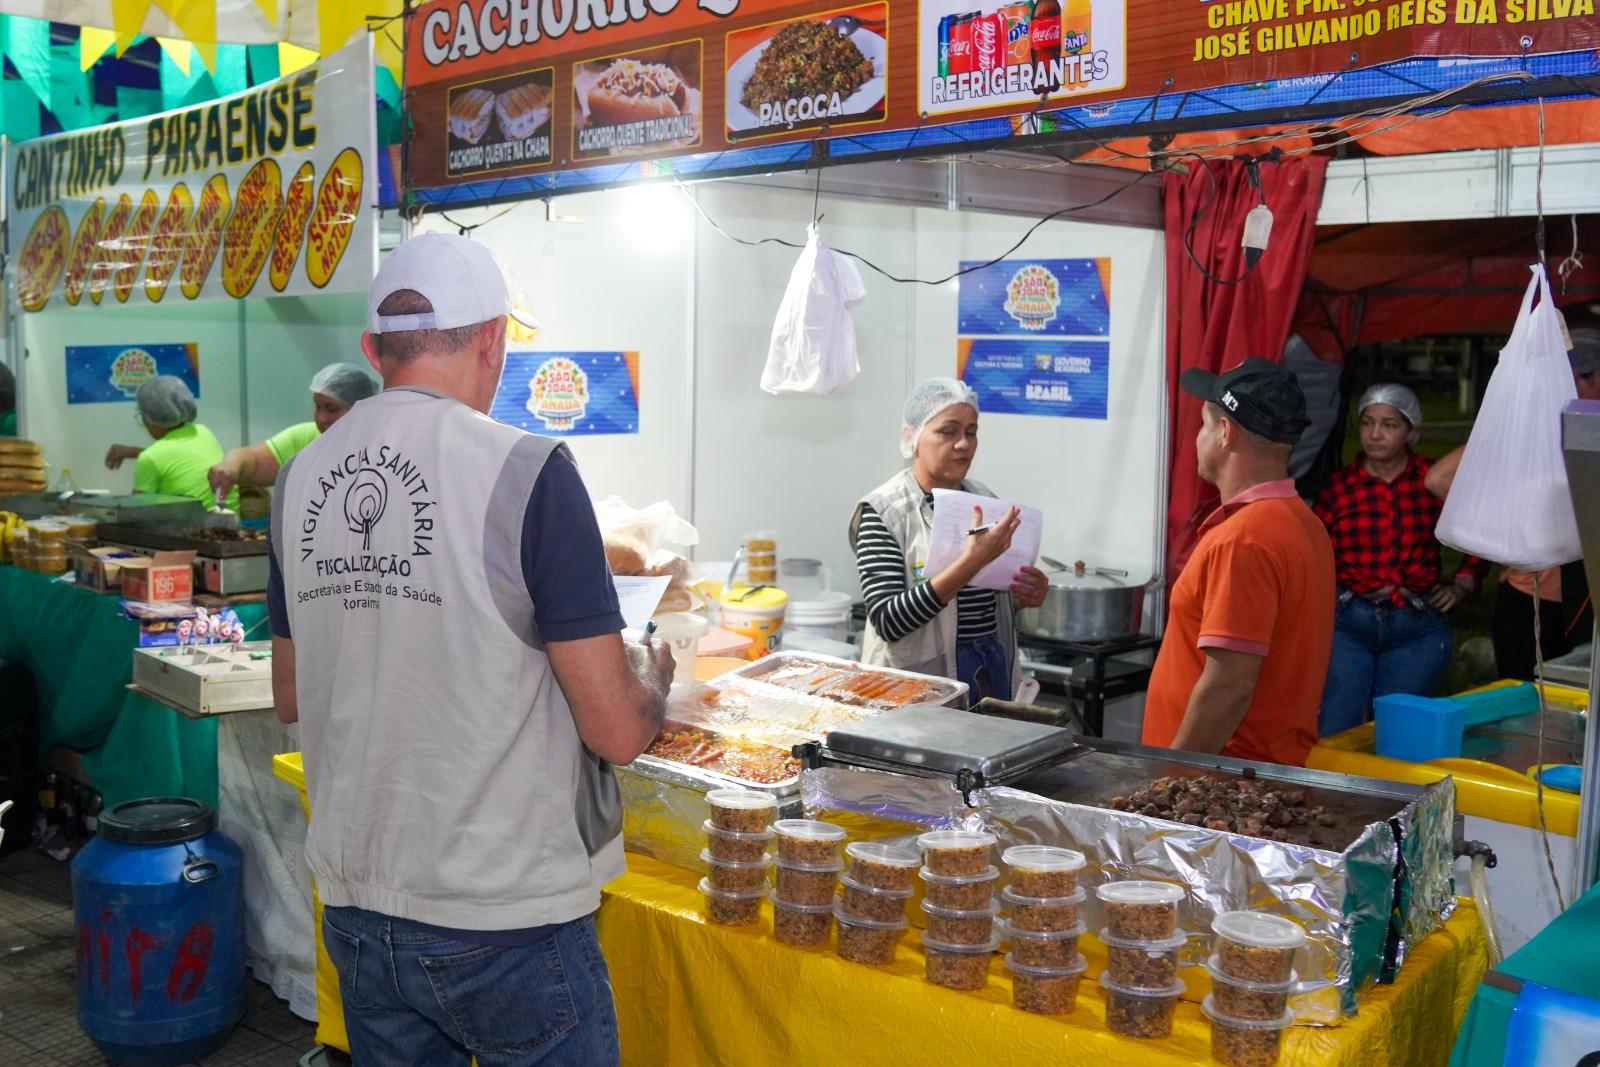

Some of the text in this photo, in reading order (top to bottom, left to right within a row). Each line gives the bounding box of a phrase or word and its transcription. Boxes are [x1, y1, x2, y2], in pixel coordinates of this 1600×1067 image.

[422, 0, 682, 66] CACHOR
[1193, 0, 1595, 62] JOSÉ GILVANDO REIS DA SILVA
[1207, 0, 1289, 29] CHAVE
[1064, 33, 1088, 50] FANTA
[931, 50, 1109, 104] REFRIGERANTES
[759, 91, 843, 130] PAÇOCA
[14, 69, 319, 211] CANTINHO PARAENSE
[579, 113, 694, 151] CACHORRO QUENTE TRADICIONAL
[449, 136, 550, 170] CACHORRO QUENTE NA CHAPA
[309, 166, 345, 253] SUCO
[301, 445, 437, 562] VIGILÂNCA SANITÁRIA
[316, 553, 411, 578] FISCALIZAÇÃO
[385, 582, 398, 597] da
[402, 585, 442, 607] Saúde
